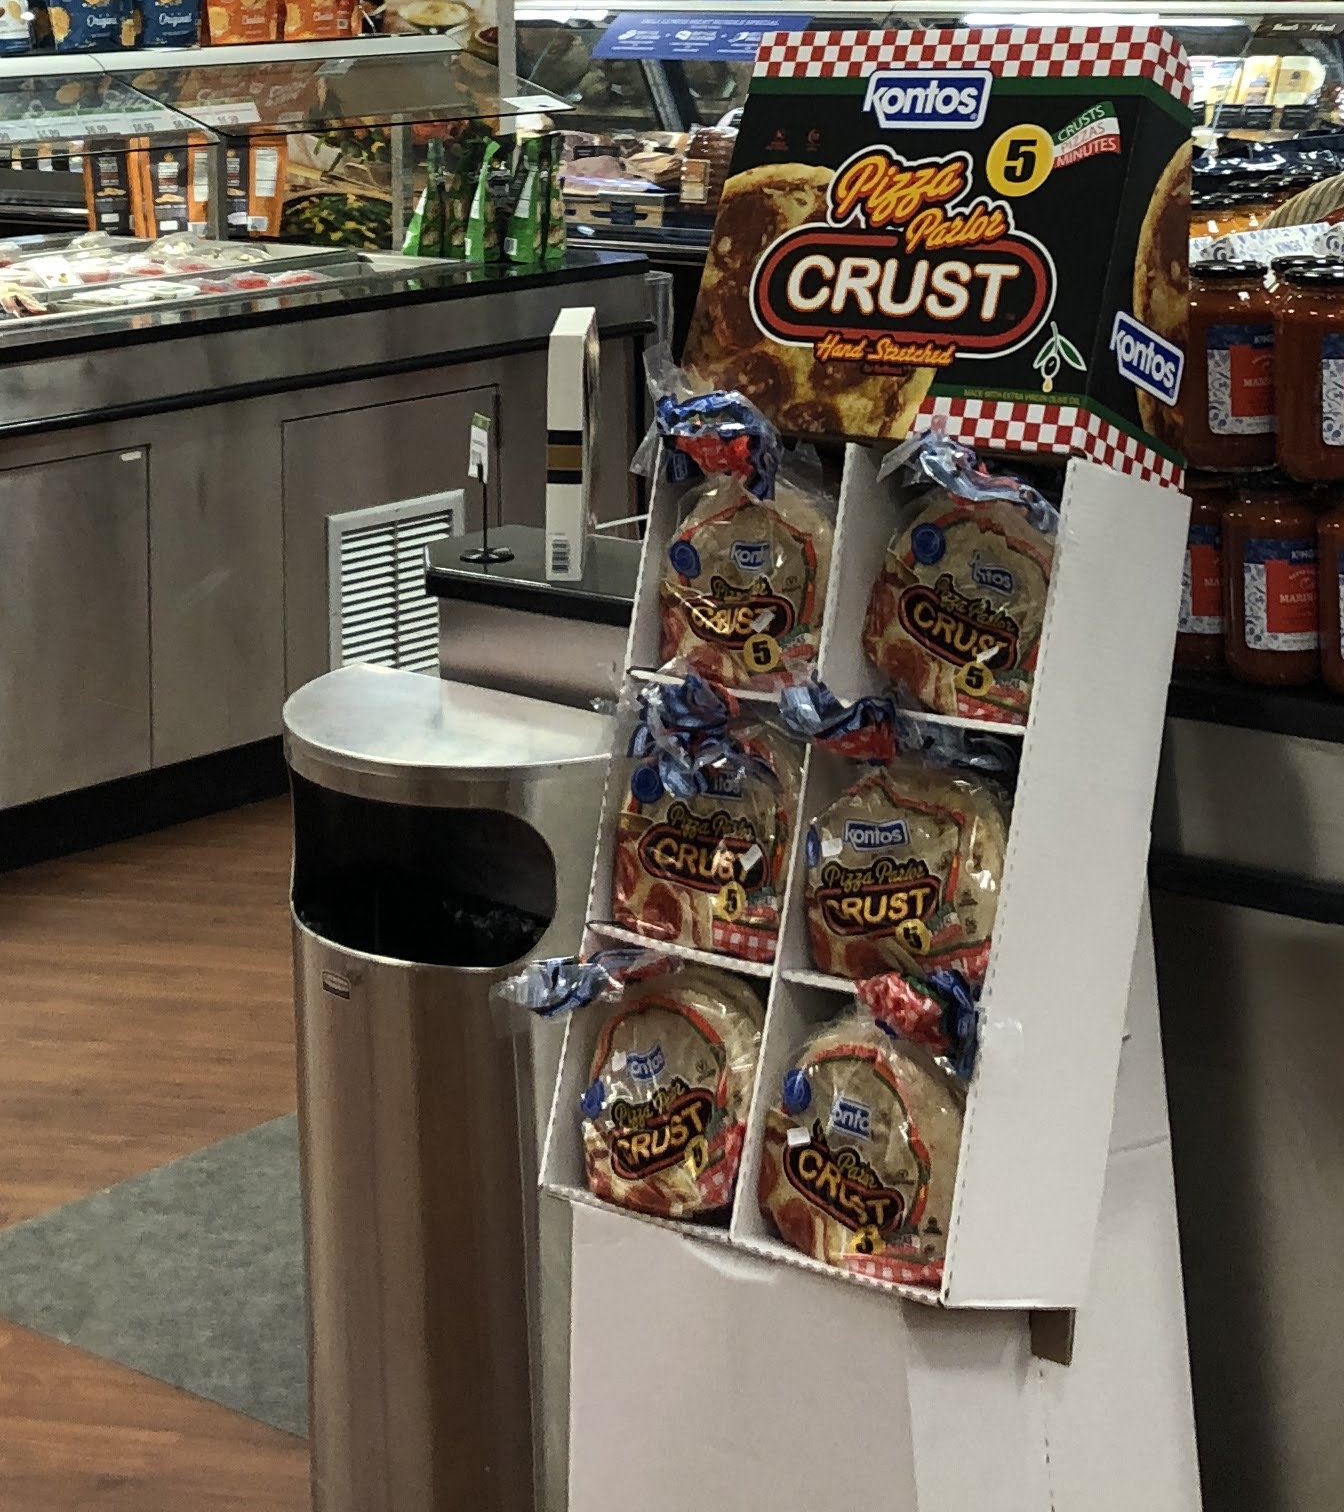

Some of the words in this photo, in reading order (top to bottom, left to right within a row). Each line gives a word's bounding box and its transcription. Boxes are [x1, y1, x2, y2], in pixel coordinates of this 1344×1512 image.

[863, 80, 978, 116] kontos
[1057, 104, 1106, 141] CRUSTS
[1061, 122, 1106, 153] PIZZAS
[1003, 139, 1038, 184] 5
[1056, 138, 1117, 167] MINUTES
[836, 154, 966, 227] Pizza
[905, 205, 1007, 254] Parlor
[786, 254, 1022, 322] CRUST
[1109, 329, 1176, 394] kontos
[752, 640, 772, 665] 5
[964, 668, 984, 689] 5
[824, 864, 874, 891] Pizza
[725, 889, 739, 913] 5
[902, 924, 923, 949] 5
